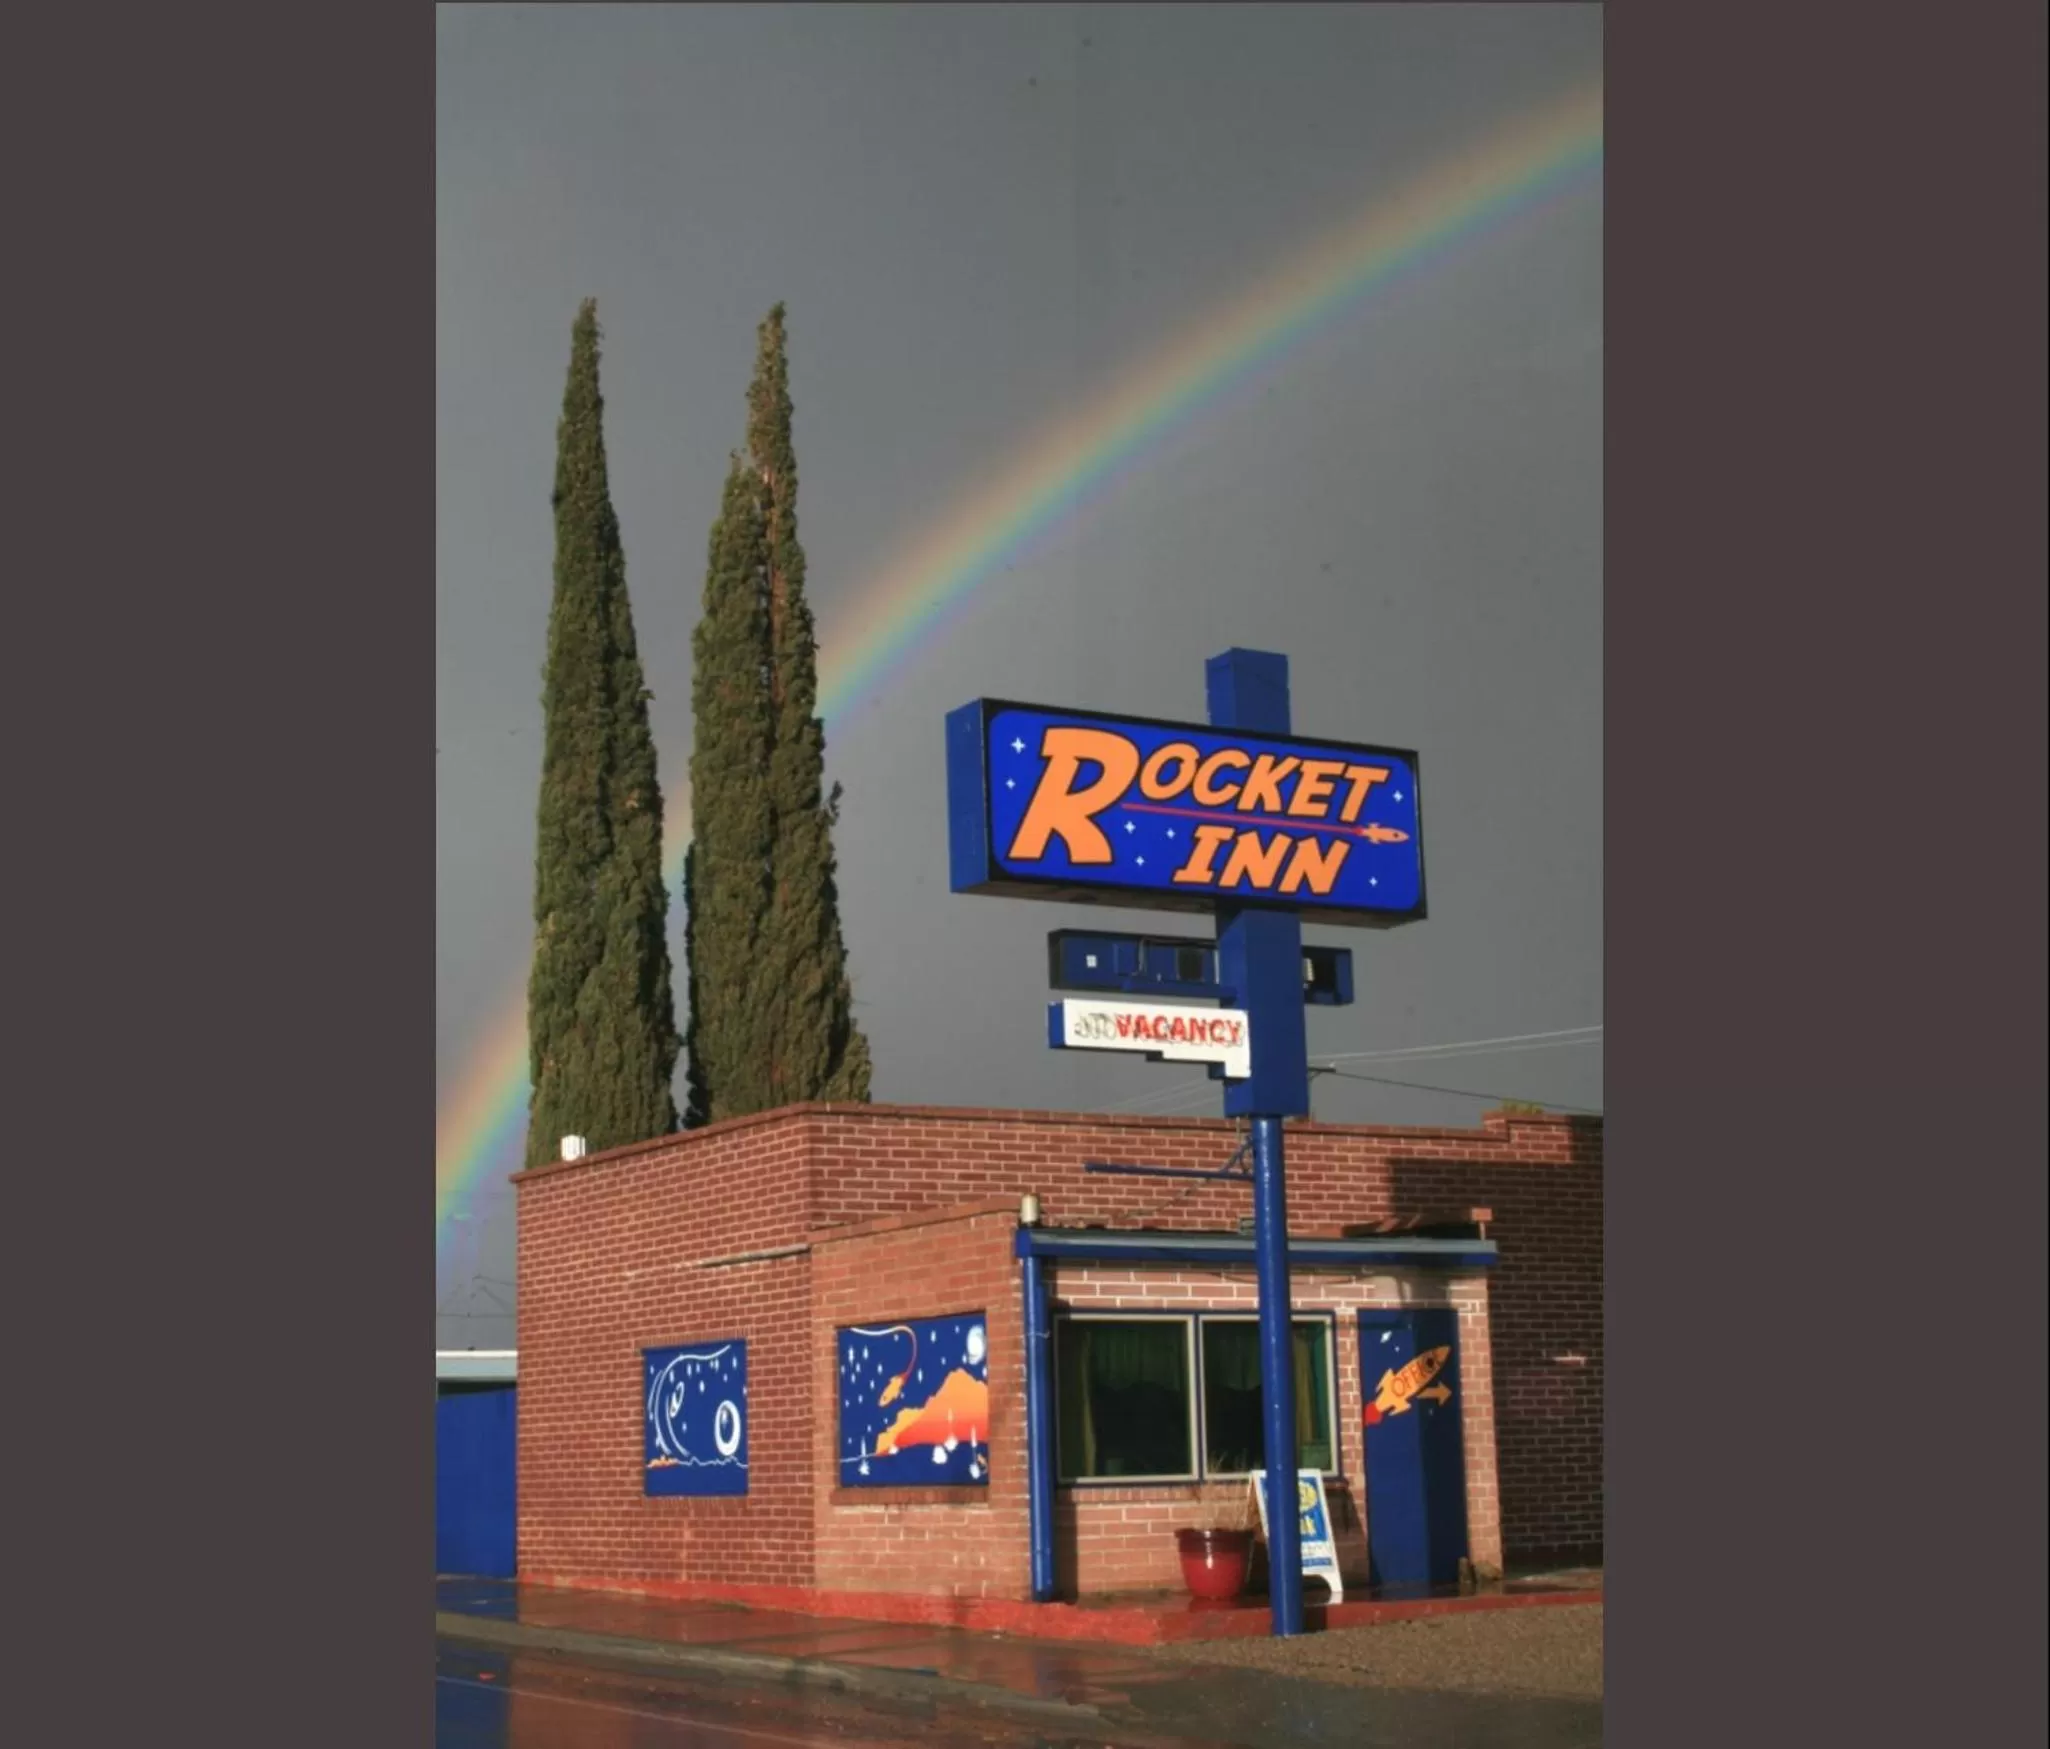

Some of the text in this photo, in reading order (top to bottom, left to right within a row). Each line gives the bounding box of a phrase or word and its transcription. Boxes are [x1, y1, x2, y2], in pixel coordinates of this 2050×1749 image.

[1006, 725, 1391, 864] ROCKET
[1172, 825, 1351, 894] INN
[1115, 1013, 1242, 1045] VACANCY
